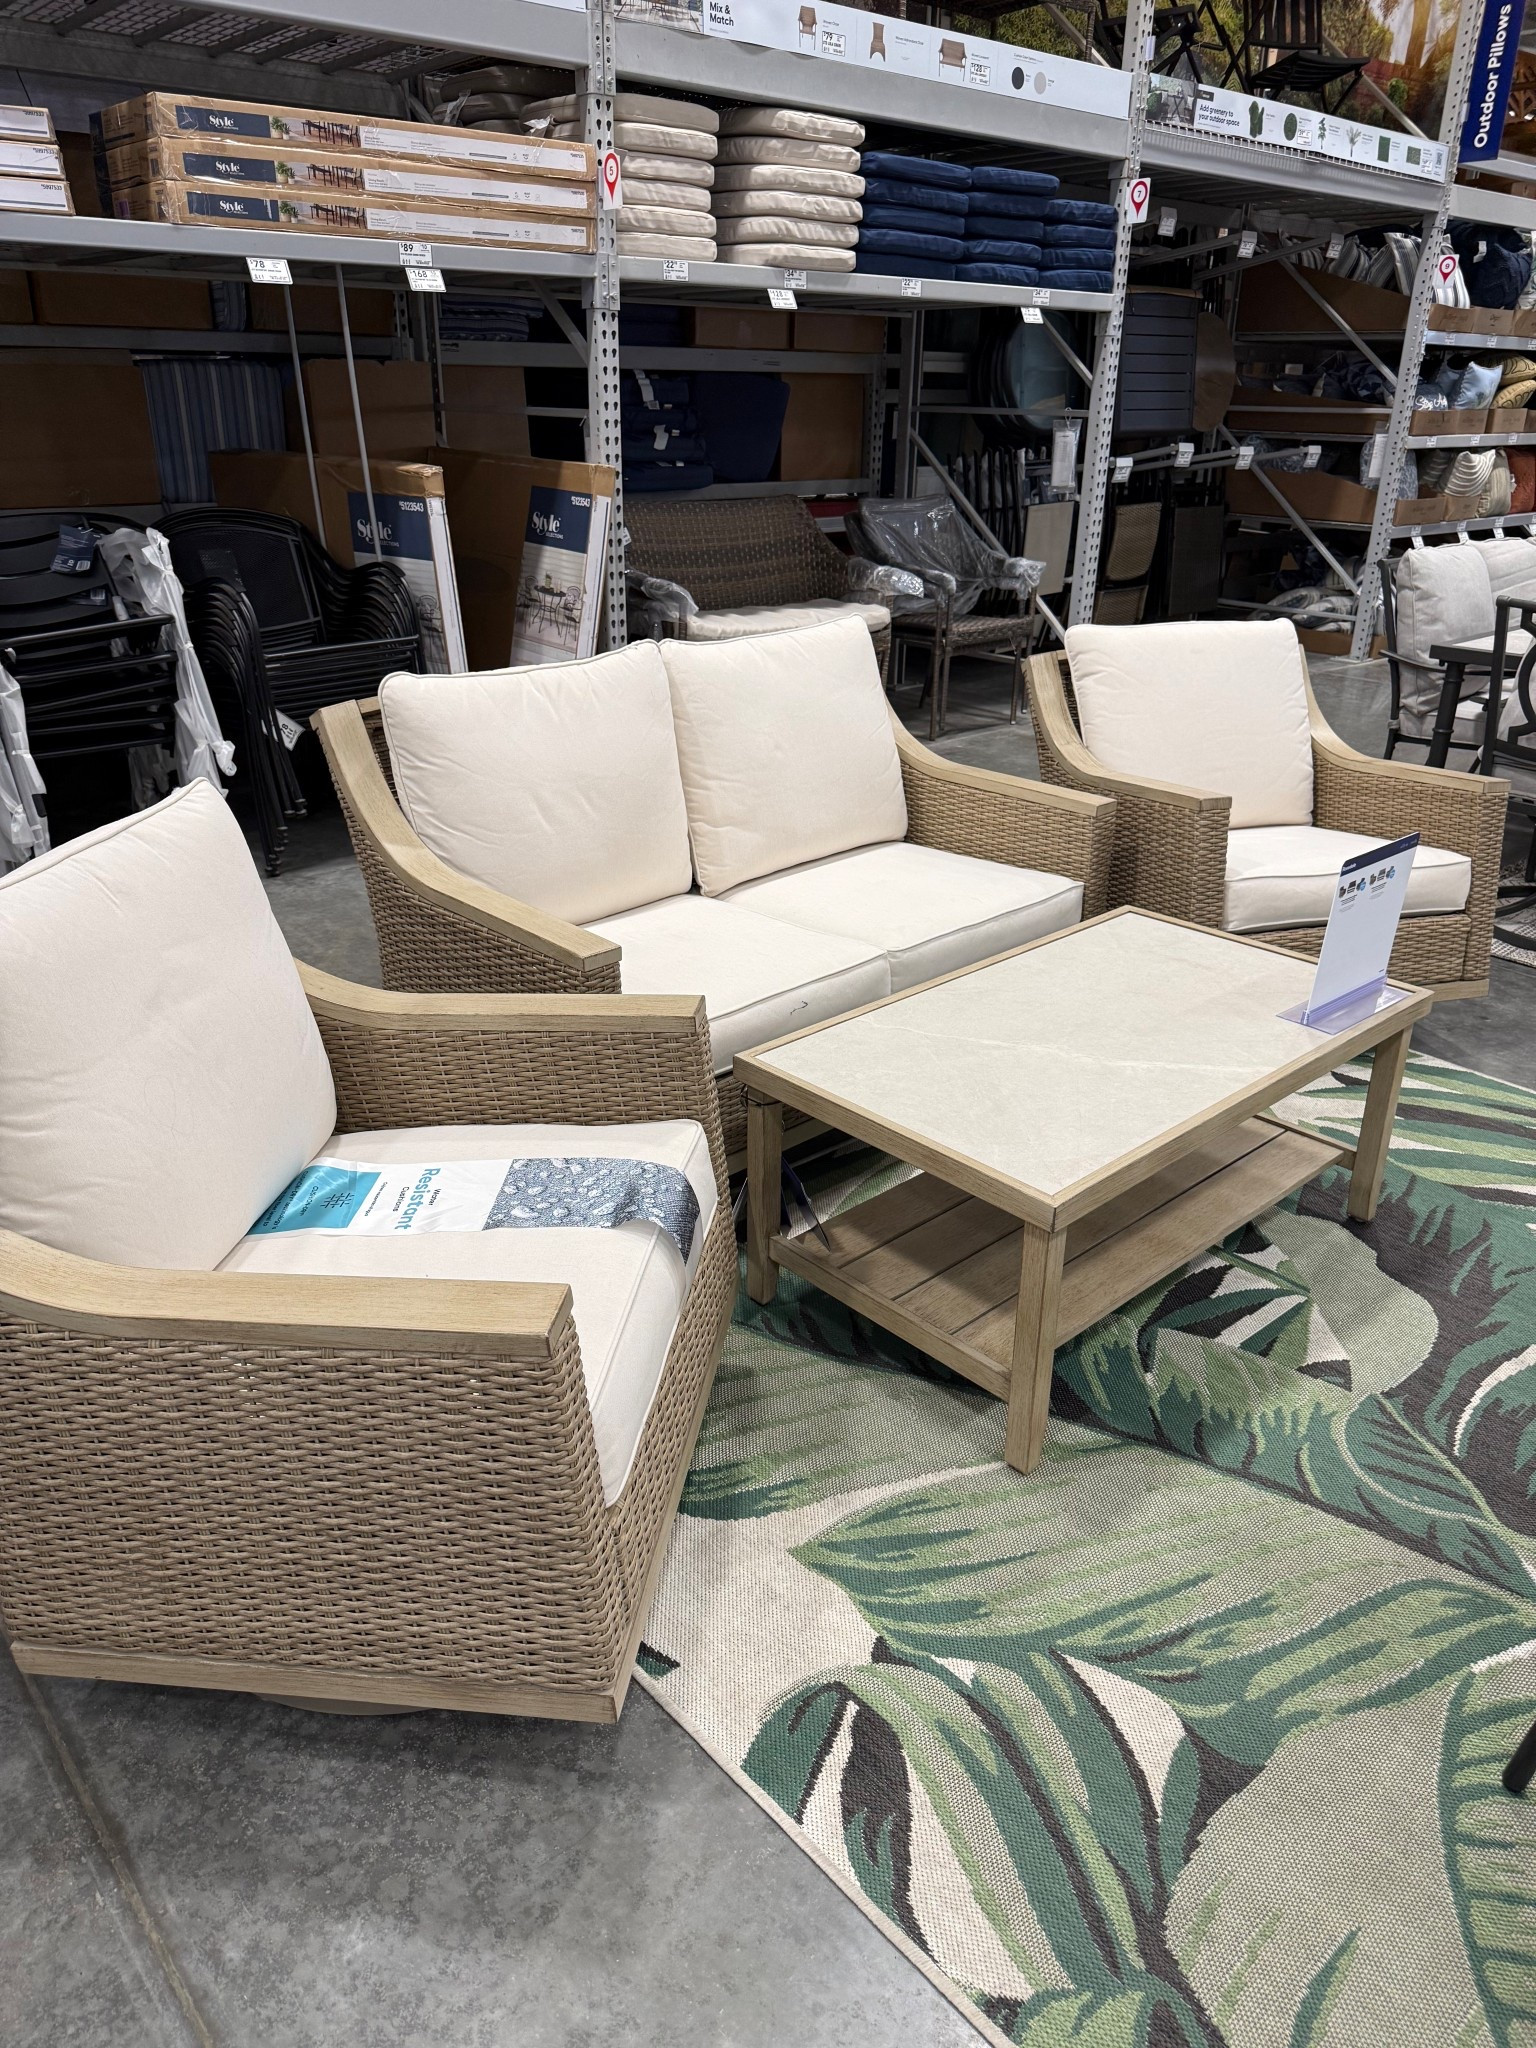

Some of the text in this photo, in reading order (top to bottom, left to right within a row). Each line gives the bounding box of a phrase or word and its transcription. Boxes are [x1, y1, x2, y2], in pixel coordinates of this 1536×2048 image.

[709, 2, 731, 15] Mix &
[709, 13, 734, 27] Match
[1474, 3, 1512, 148] Outdoor Pillows
[1200, 104, 1209, 112] Add
[1209, 107, 1228, 117] greenery
[209, 114, 234, 129] Style
[1209, 115, 1226, 124] outdoor
[215, 161, 240, 175] Style
[610, 166, 614, 176] 5
[220, 200, 244, 215] Style
[400, 243, 414, 252] $89
[531, 511, 561, 535] Style
[392, 1186, 410, 1212] Cushions
[393, 1167, 442, 1230] Resistant
